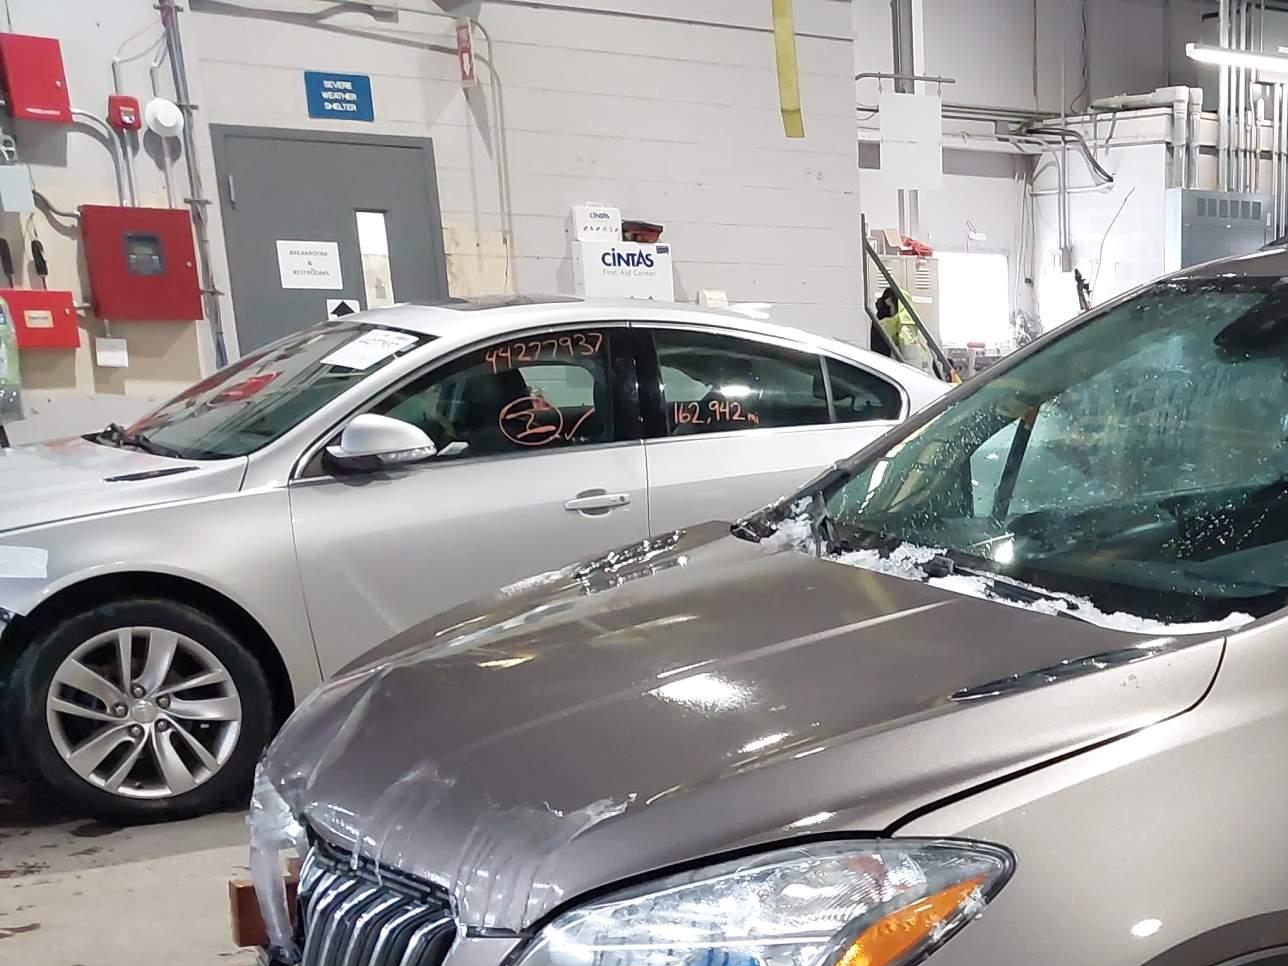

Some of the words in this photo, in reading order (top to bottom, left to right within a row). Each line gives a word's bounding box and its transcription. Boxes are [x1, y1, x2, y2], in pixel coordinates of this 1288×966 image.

[323, 80, 353, 90] SEVERE
[320, 90, 358, 101] WEATHER
[323, 101, 357, 111] SHELTER
[485, 333, 602, 374] 44277937
[674, 400, 746, 425] 162,942
